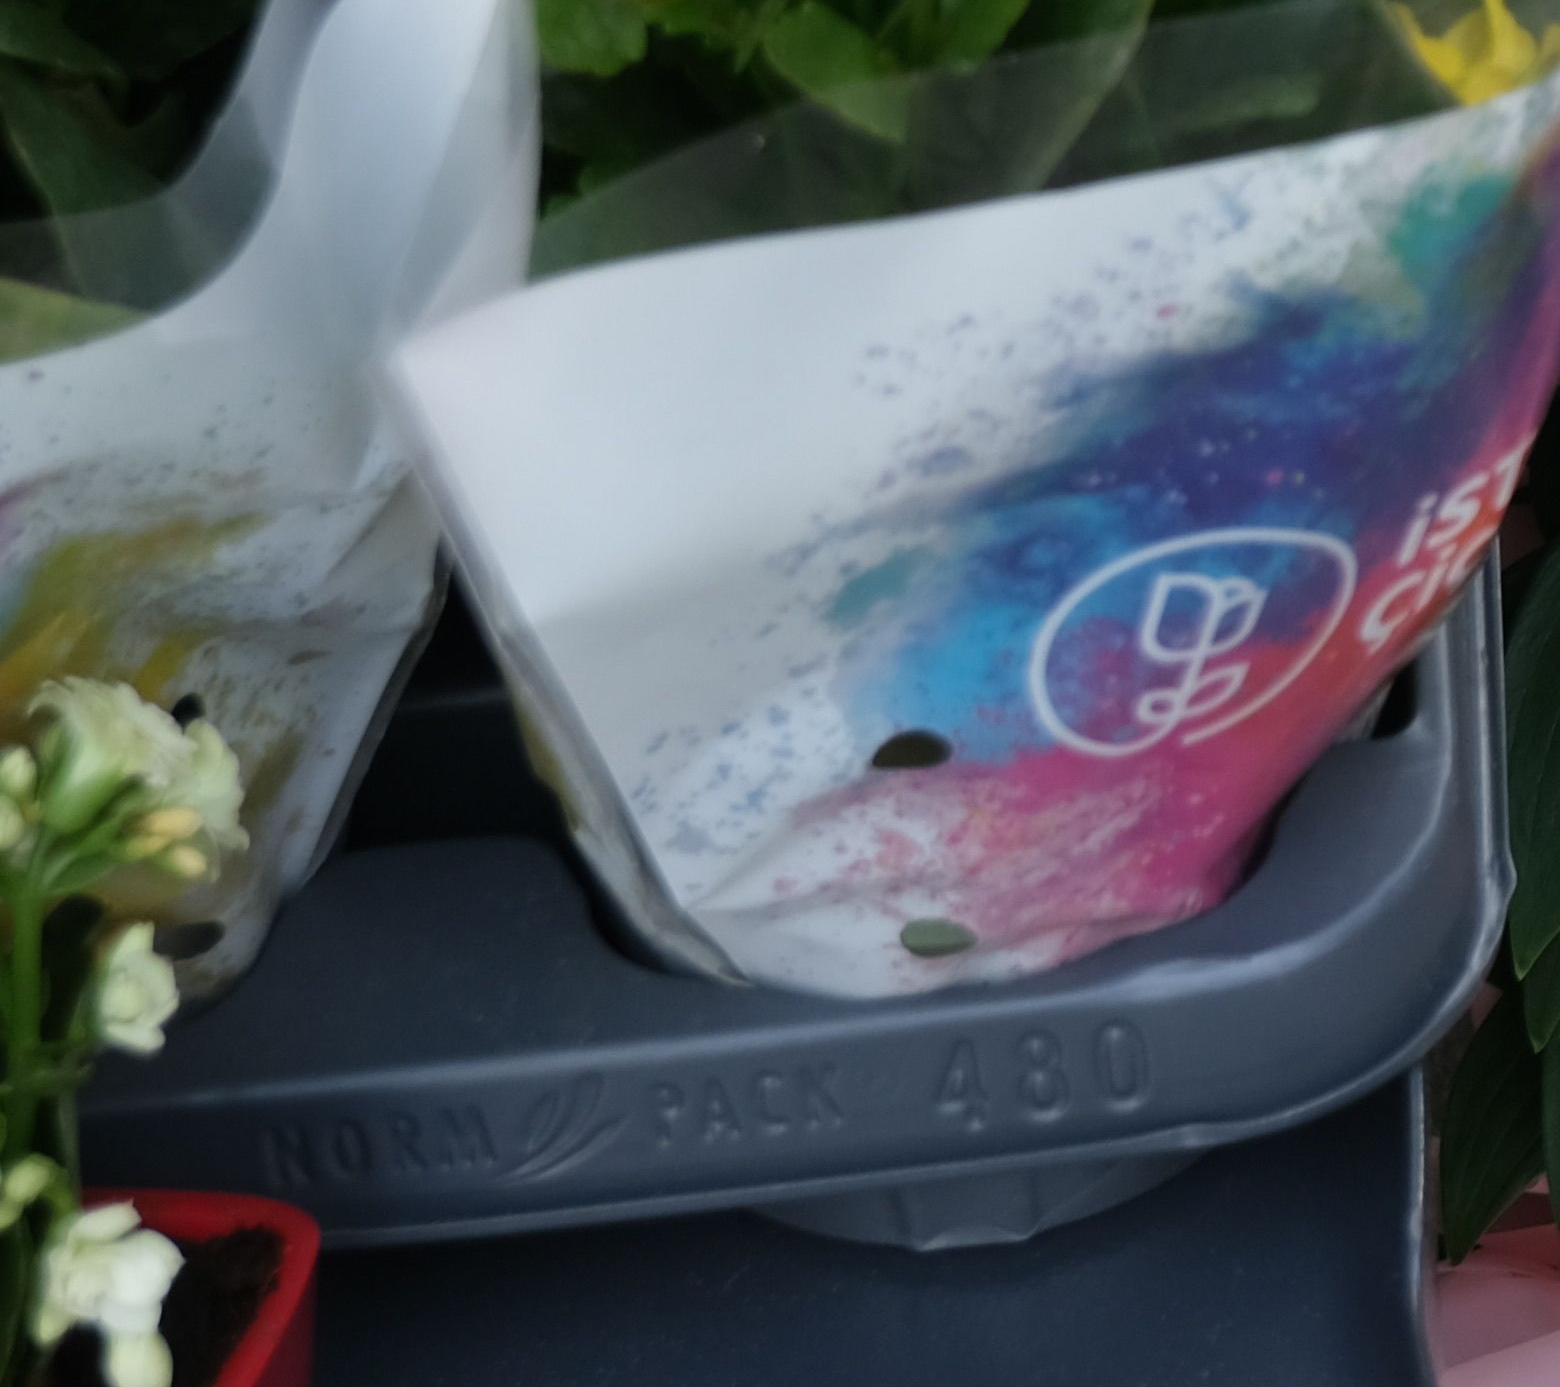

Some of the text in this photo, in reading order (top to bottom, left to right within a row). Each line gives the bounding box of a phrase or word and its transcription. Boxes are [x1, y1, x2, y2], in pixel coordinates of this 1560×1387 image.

[264, 1018, 1150, 1187] NORM PACK 480
